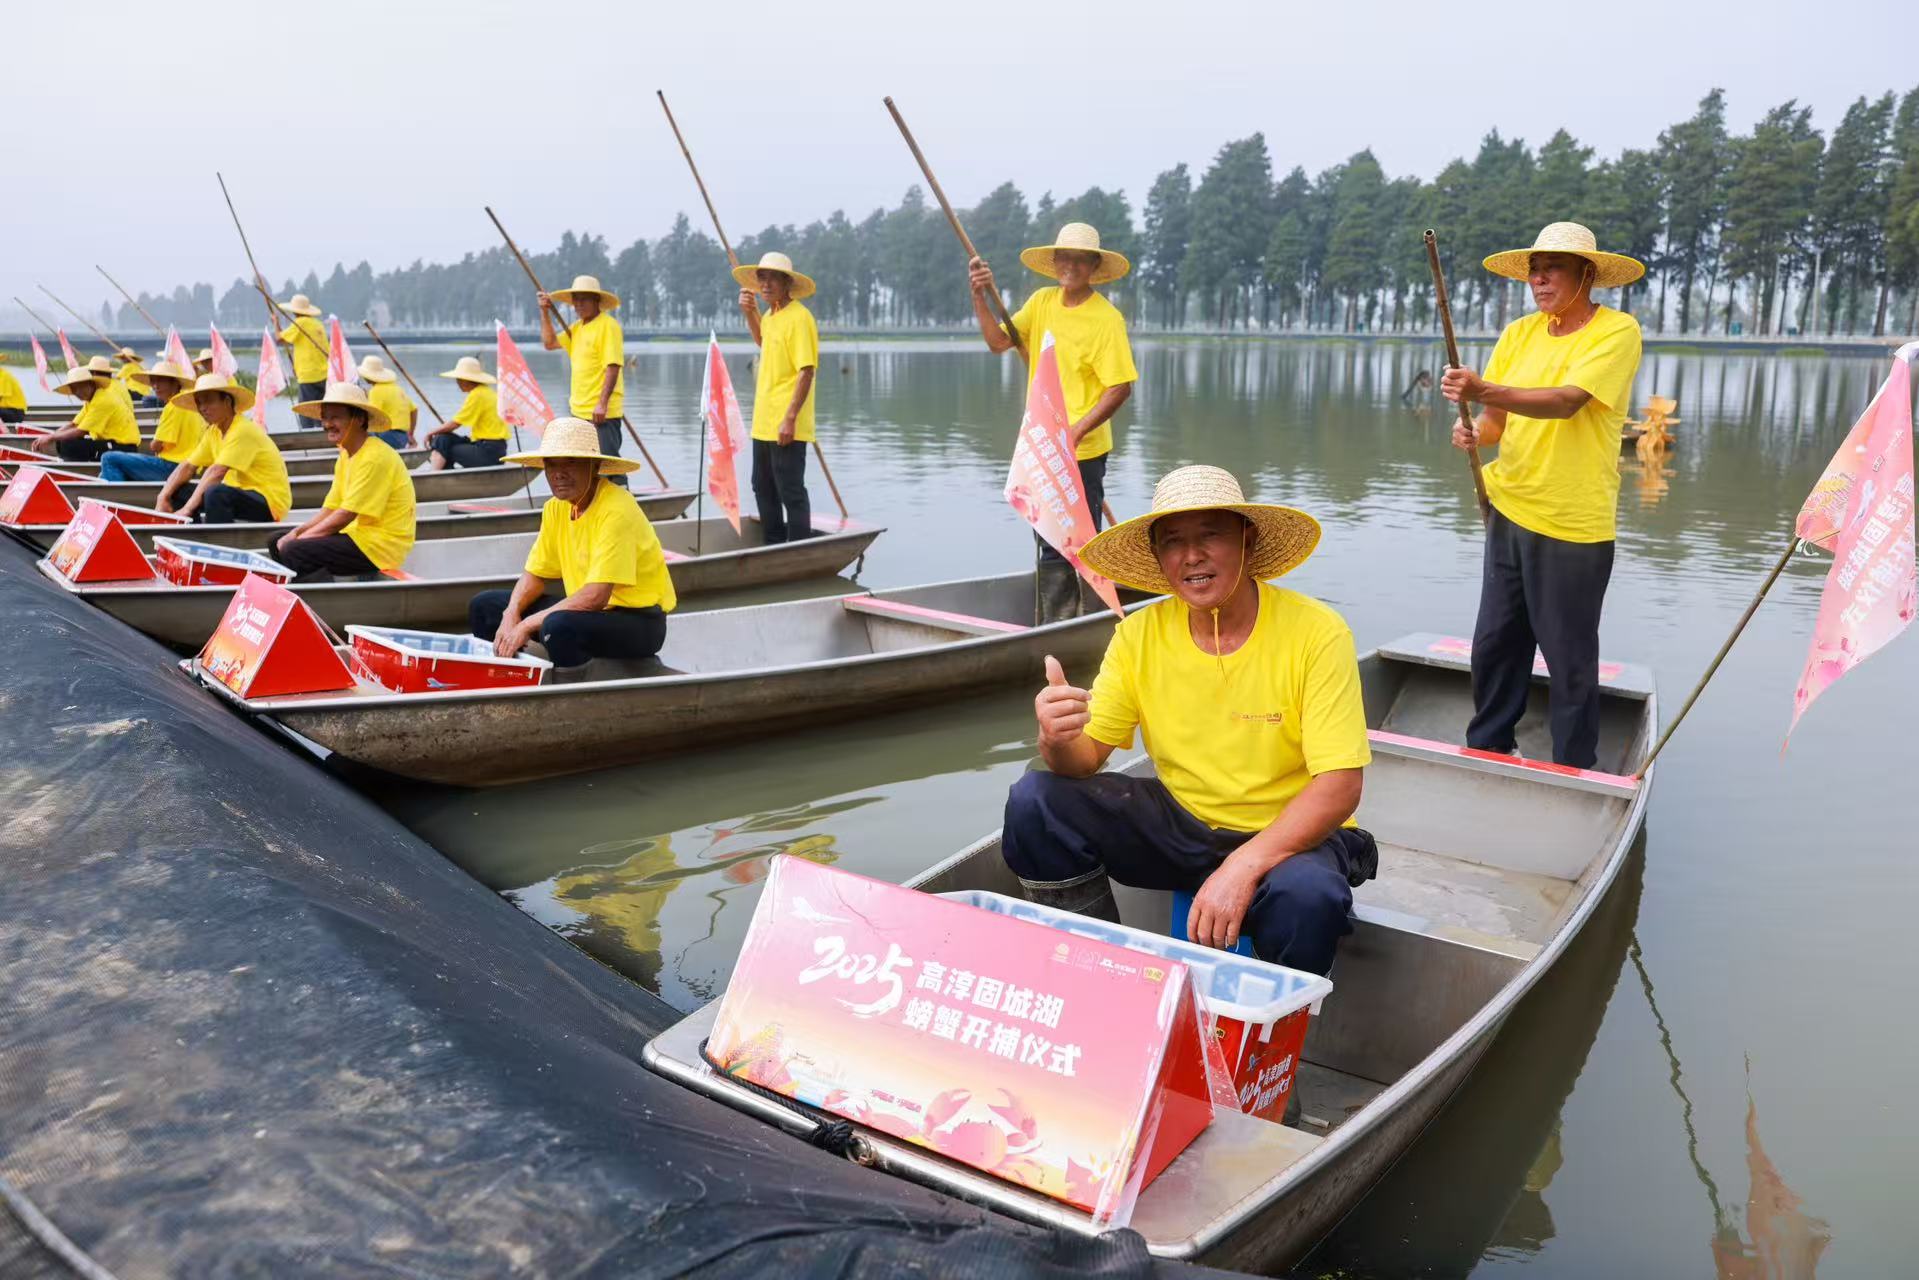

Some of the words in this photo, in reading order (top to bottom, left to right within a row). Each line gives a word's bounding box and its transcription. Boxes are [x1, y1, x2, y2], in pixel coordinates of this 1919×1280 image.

[799, 936, 913, 1018] 2025
[915, 960, 1065, 1029] 高淳固城湖
[902, 997, 1082, 1077] 螃蟹开捕仪式
